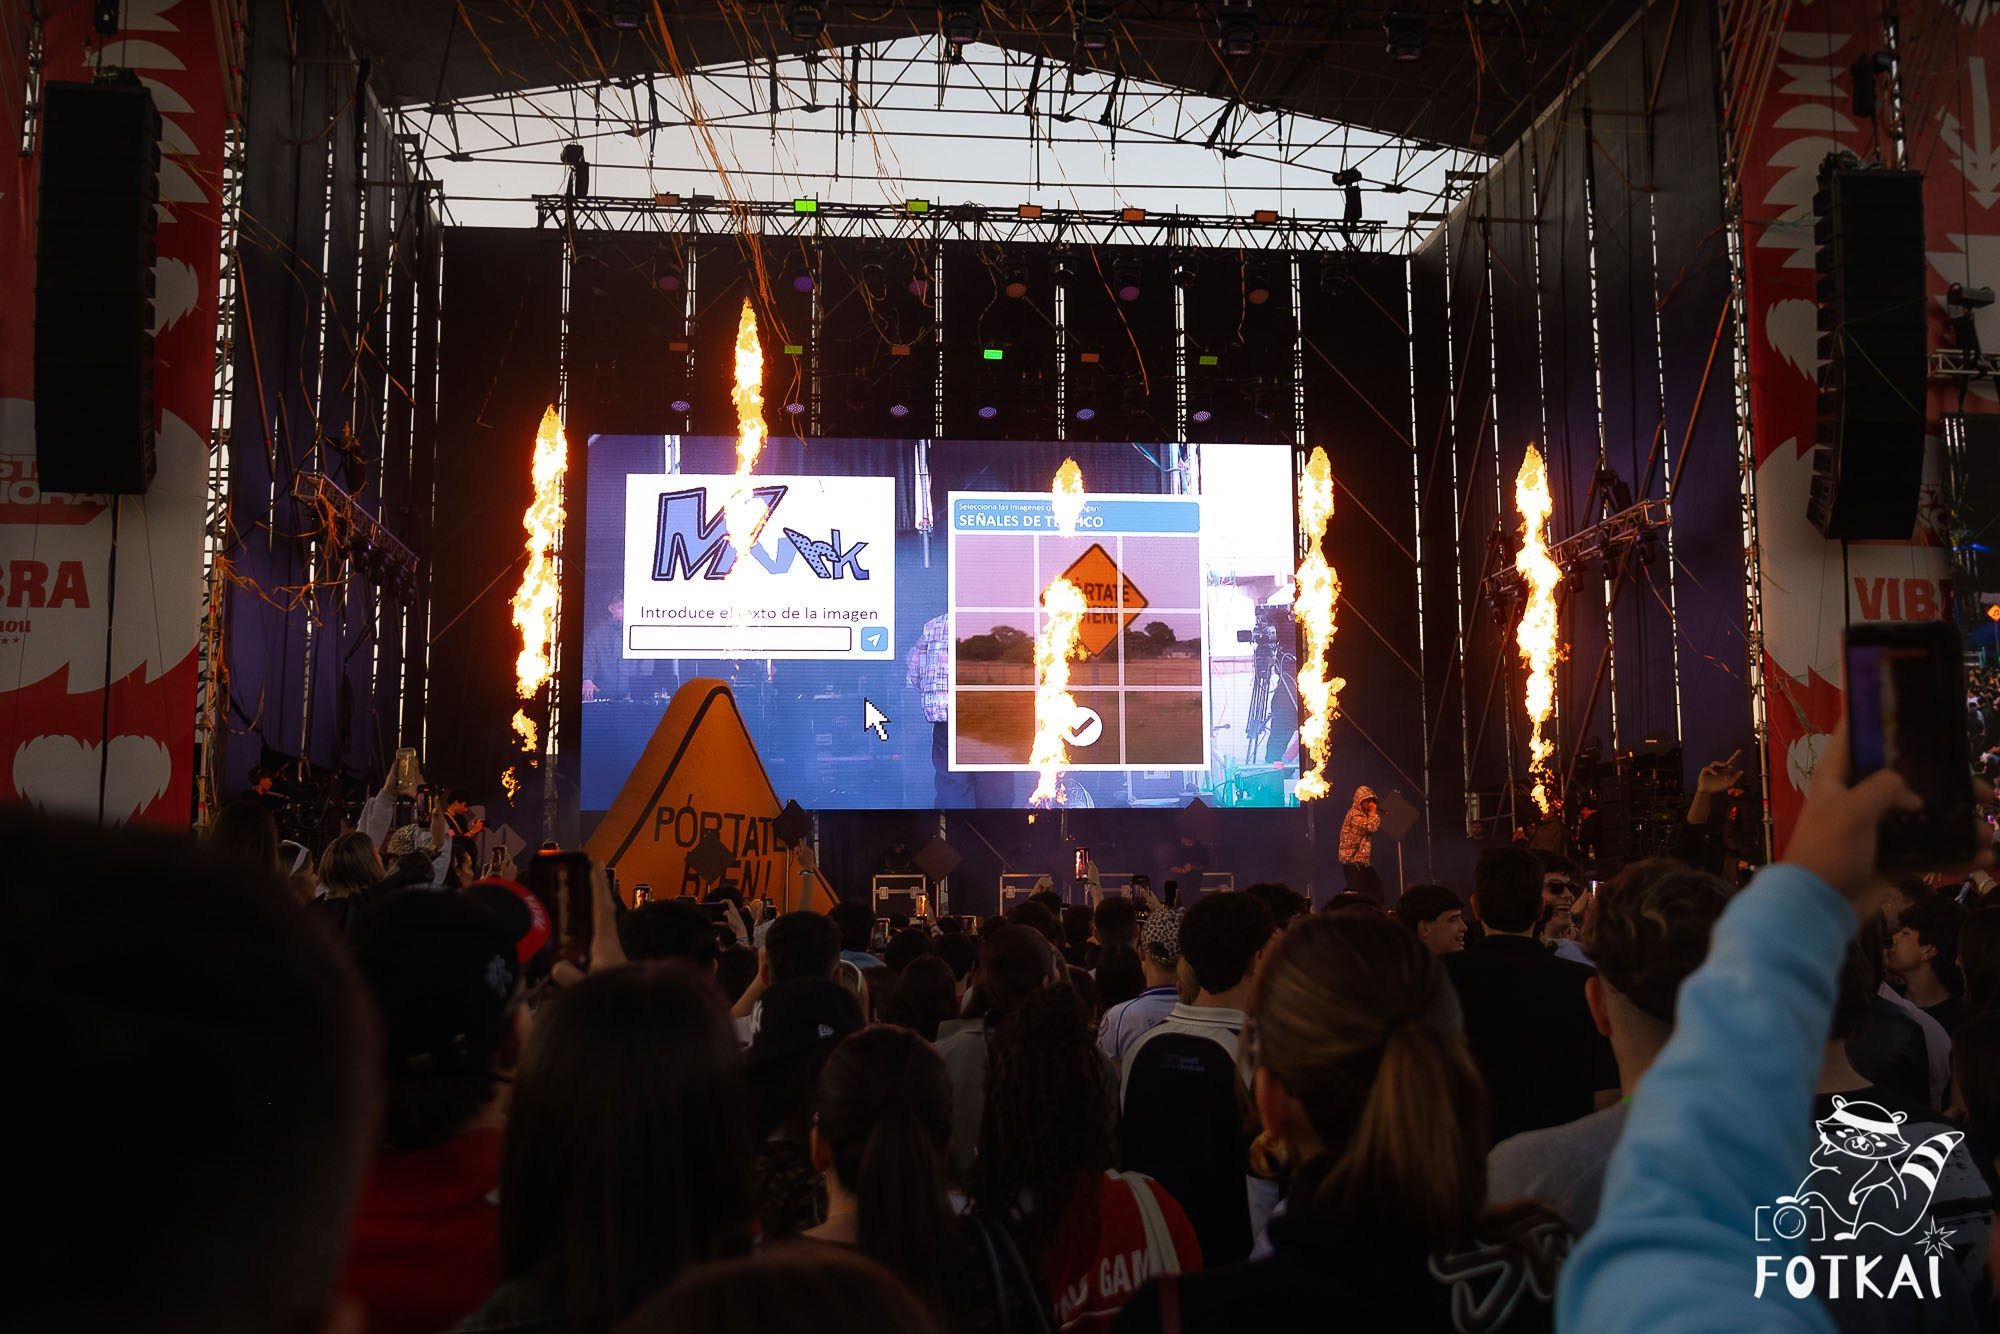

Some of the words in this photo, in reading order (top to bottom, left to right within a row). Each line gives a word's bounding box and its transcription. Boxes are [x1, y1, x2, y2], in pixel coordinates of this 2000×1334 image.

[959, 502, 997, 511] Selecciona
[998, 503, 1009, 511] las
[959, 511, 1019, 528] SEÑALES
[1022, 514, 1041, 527] DE
[0, 560, 90, 608] RA
[641, 606, 715, 620] Introduce
[782, 606, 800, 620] de
[805, 606, 817, 620] la
[823, 607, 878, 622] imagen
